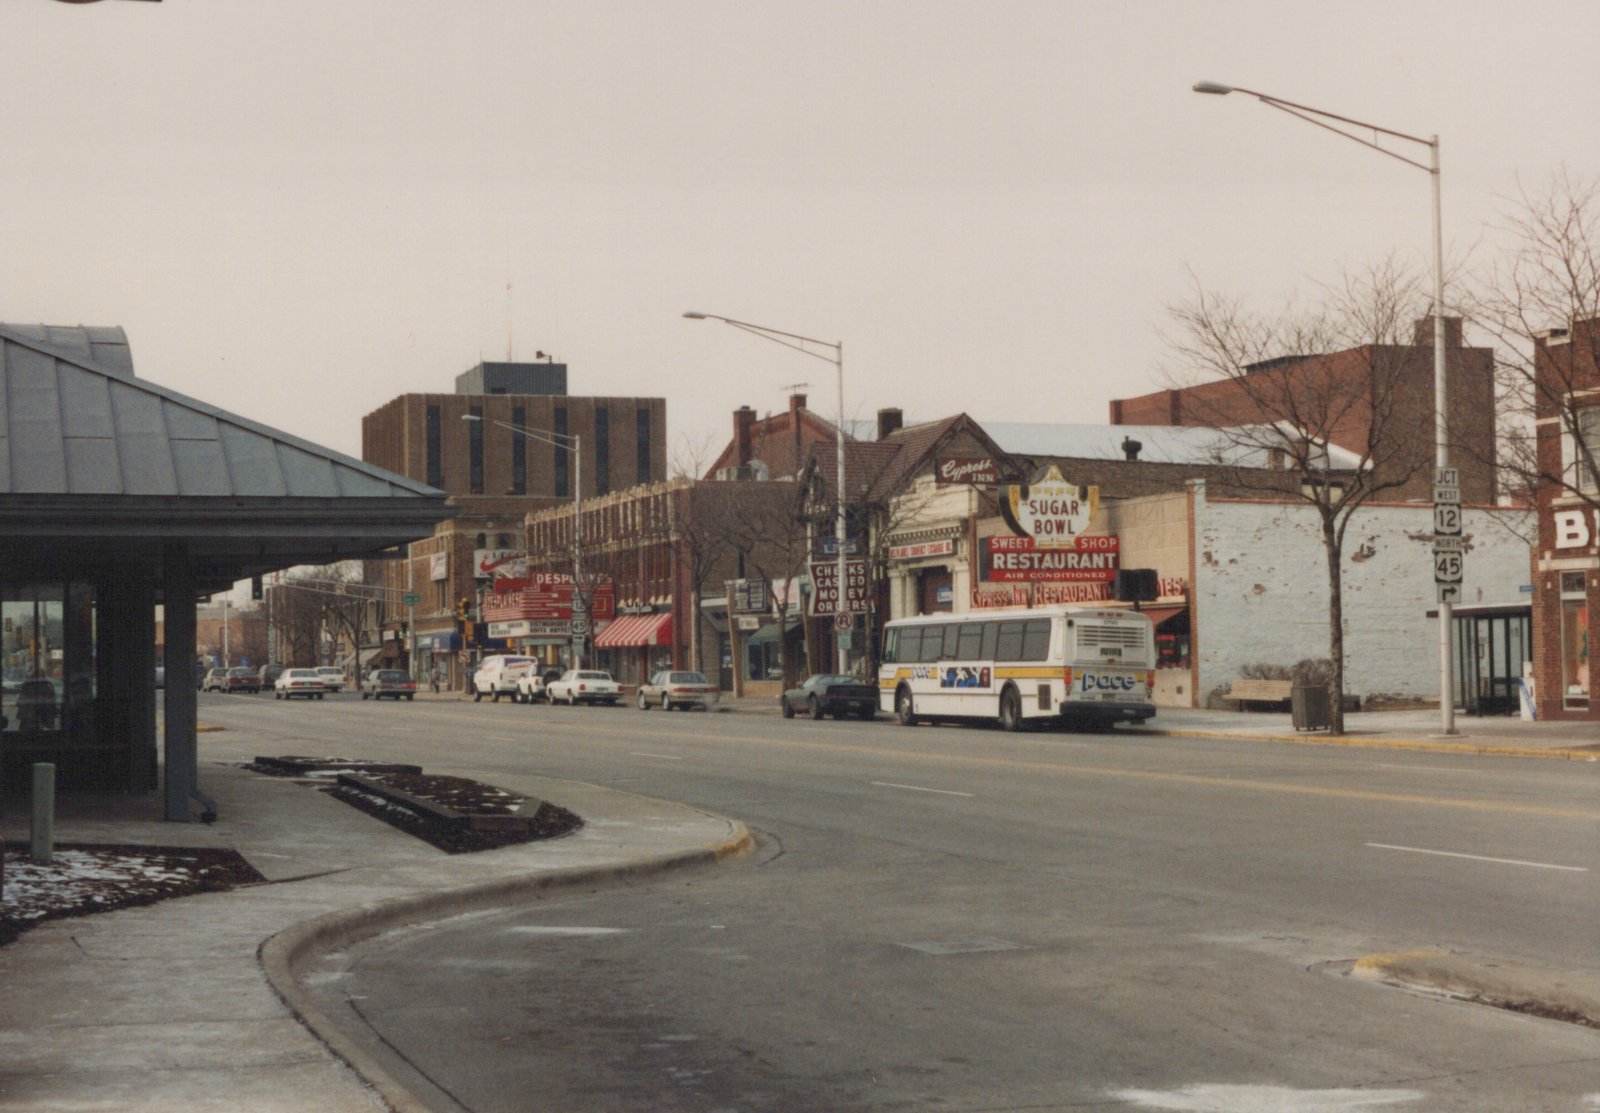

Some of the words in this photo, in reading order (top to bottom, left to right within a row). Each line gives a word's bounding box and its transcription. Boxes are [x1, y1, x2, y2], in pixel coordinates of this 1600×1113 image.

[942, 459, 993, 482] Cypress
[972, 473, 994, 482] INN
[1438, 470, 1457, 484] JCT
[1437, 490, 1457, 500] WEST
[1029, 499, 1079, 516] SUGAR
[1439, 509, 1456, 527] 12
[1034, 519, 1075, 535] BOWL
[992, 538, 1029, 549] SWEET
[1081, 538, 1117, 549] SHOP
[1435, 538, 1461, 549] NORTH
[993, 552, 1116, 569] RESTAURANT
[1438, 557, 1460, 576] 45
[816, 564, 865, 577] CHEKS
[1004, 571, 1024, 579] AIR
[1029, 571, 1107, 579] CONDITIONED
[817, 576, 865, 588] CASED
[819, 588, 864, 600] MOEY
[818, 600, 868, 612] ORERS
[574, 621, 585, 630] 45
[1082, 672, 1136, 692] pace
